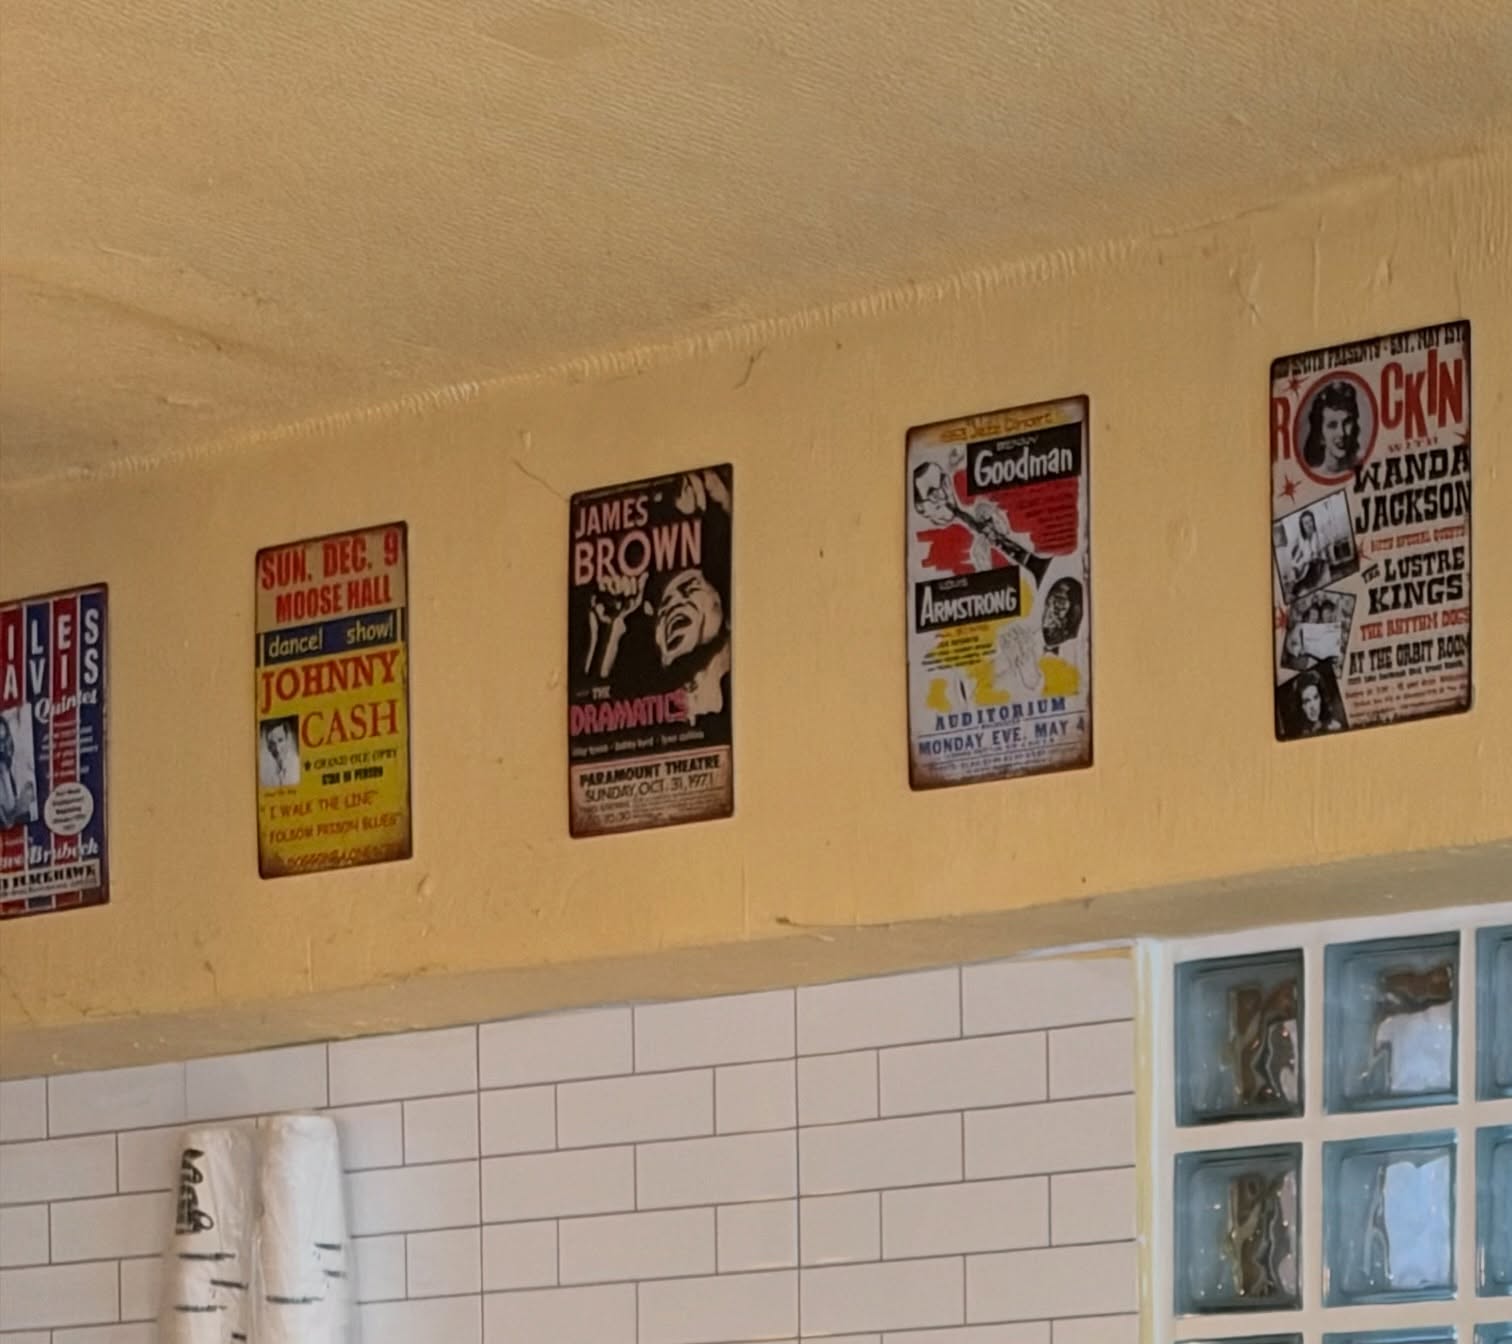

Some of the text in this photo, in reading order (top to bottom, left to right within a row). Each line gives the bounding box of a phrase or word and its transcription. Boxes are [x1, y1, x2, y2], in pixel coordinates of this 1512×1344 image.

[974, 446, 1073, 487] Goodman
[1353, 445, 1470, 493] WANDA
[575, 495, 649, 539] JAMES
[1355, 480, 1470, 534] JACKSON
[262, 529, 398, 590] SUN. DEC. 9
[574, 519, 701, 586] BROWN
[1384, 546, 1464, 582] LUSTRE
[276, 574, 392, 624] MOOSE HALL
[921, 585, 1017, 627] ARMSTRONG
[1368, 573, 1463, 615] KINGS
[8, 609, 99, 660] ILES
[269, 612, 393, 657] dance! show!
[1360, 622, 1383, 642] THE
[4, 650, 98, 699] AVIS
[1350, 651, 1364, 675] AT
[1369, 646, 1392, 671] THE
[1396, 639, 1433, 666] ORBIT
[261, 649, 400, 715] JOHNNY
[301, 699, 399, 748] CASH
[936, 697, 1066, 731] AUDITORIUM
[918, 733, 983, 755] MONDAY
[1034, 719, 1069, 738] MAY
[580, 754, 720, 787] PARAMOUNT THEATRE
